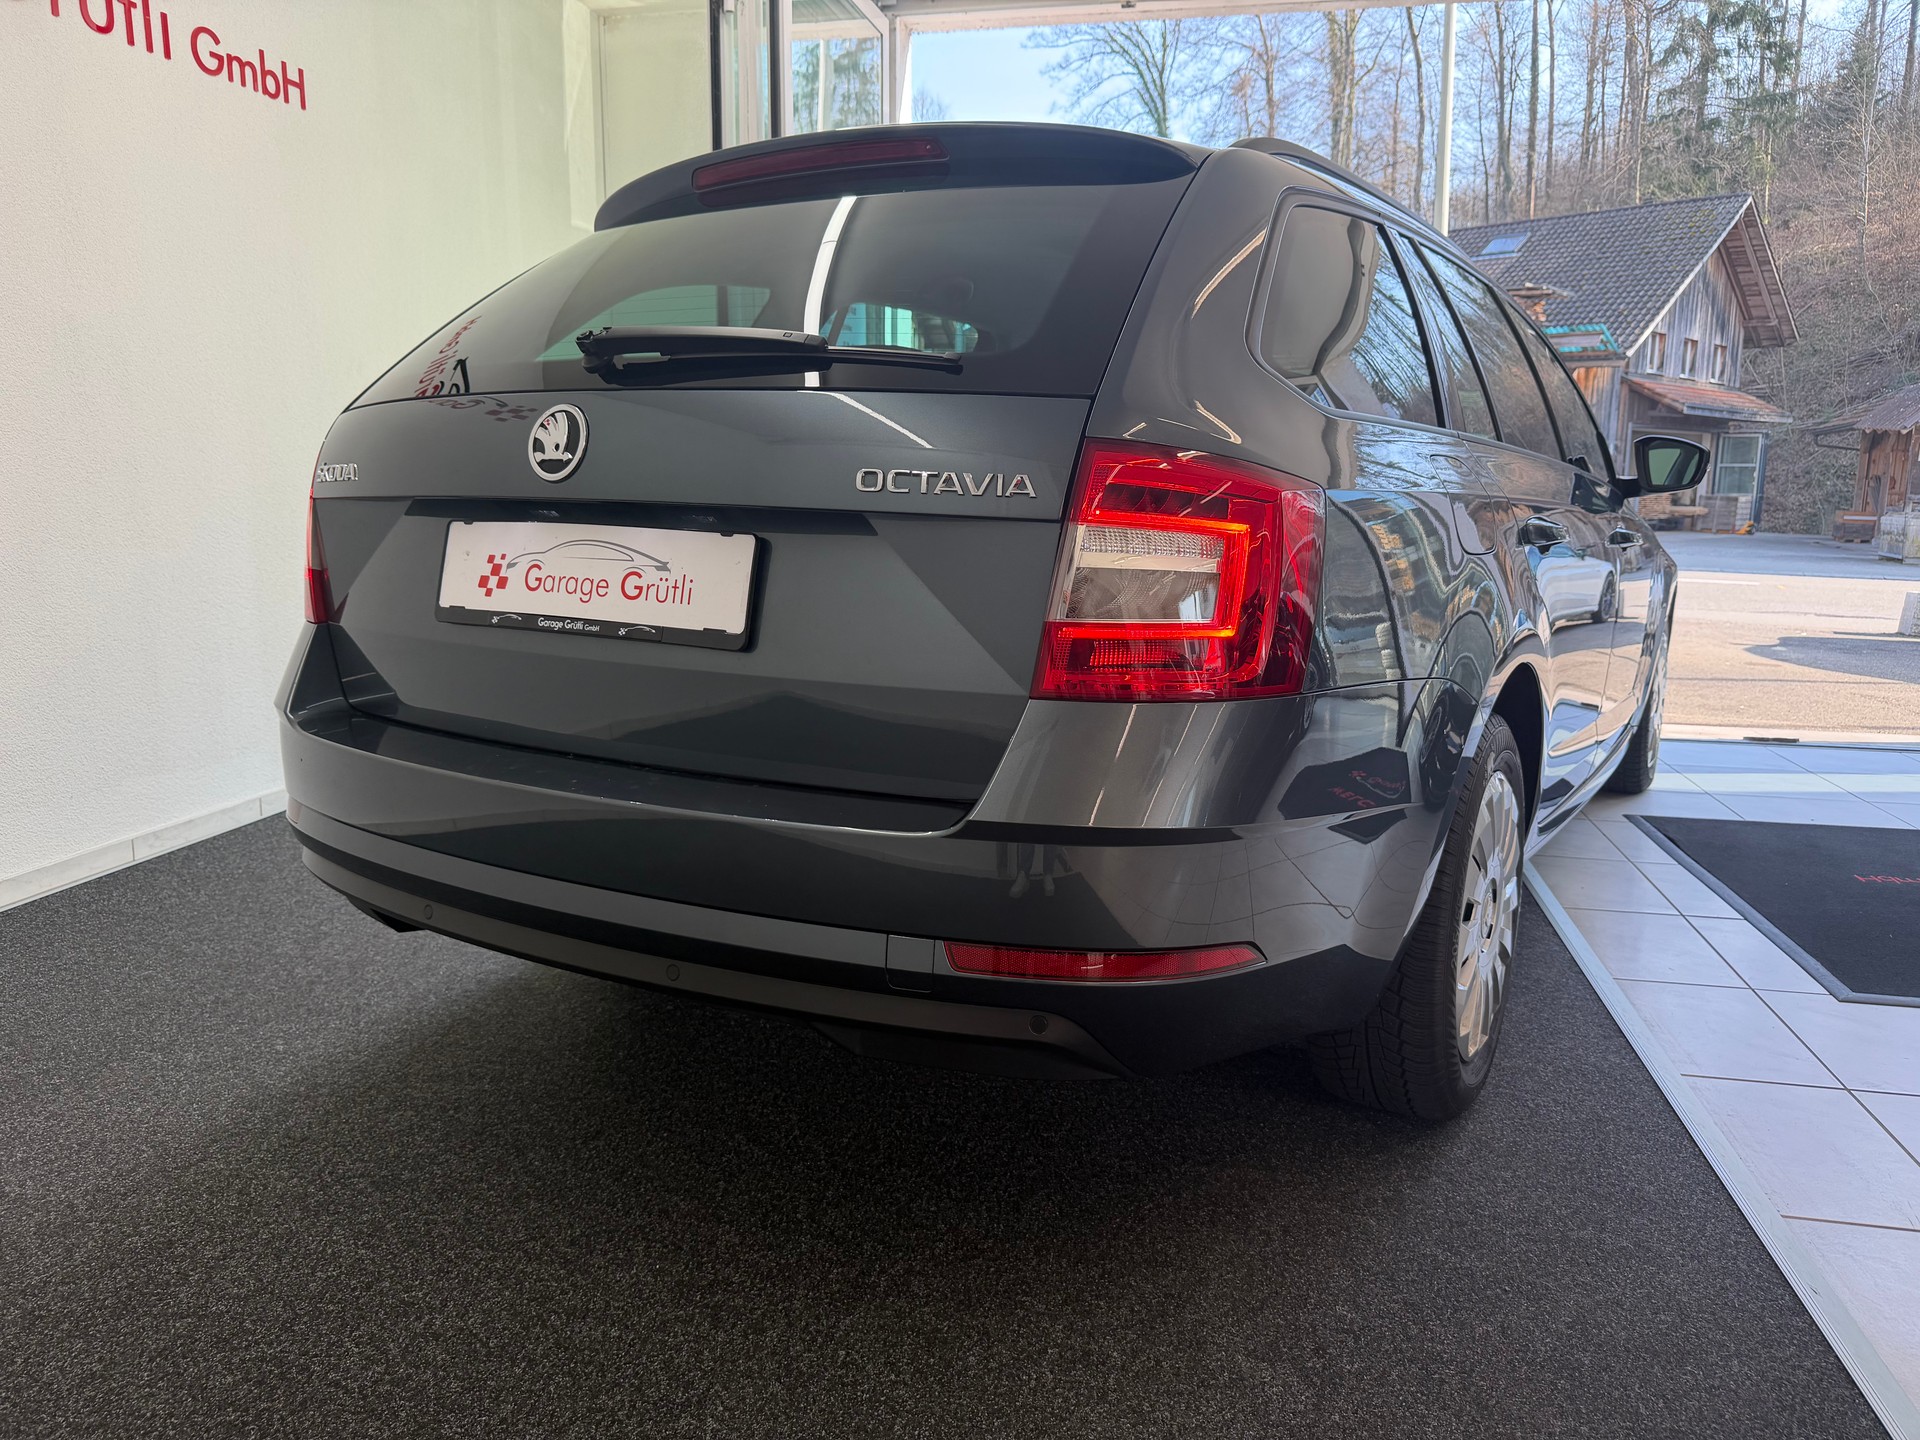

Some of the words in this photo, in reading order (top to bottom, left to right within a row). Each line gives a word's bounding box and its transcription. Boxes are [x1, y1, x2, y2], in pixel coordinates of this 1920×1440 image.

[190, 26, 307, 111] GmbH
[855, 468, 1037, 499] OCTAVIA
[524, 563, 609, 604] Garage
[620, 570, 694, 606] Grütli
[538, 617, 564, 631] Garage
[564, 619, 584, 631] Grütli
[584, 624, 600, 632] GmbH
